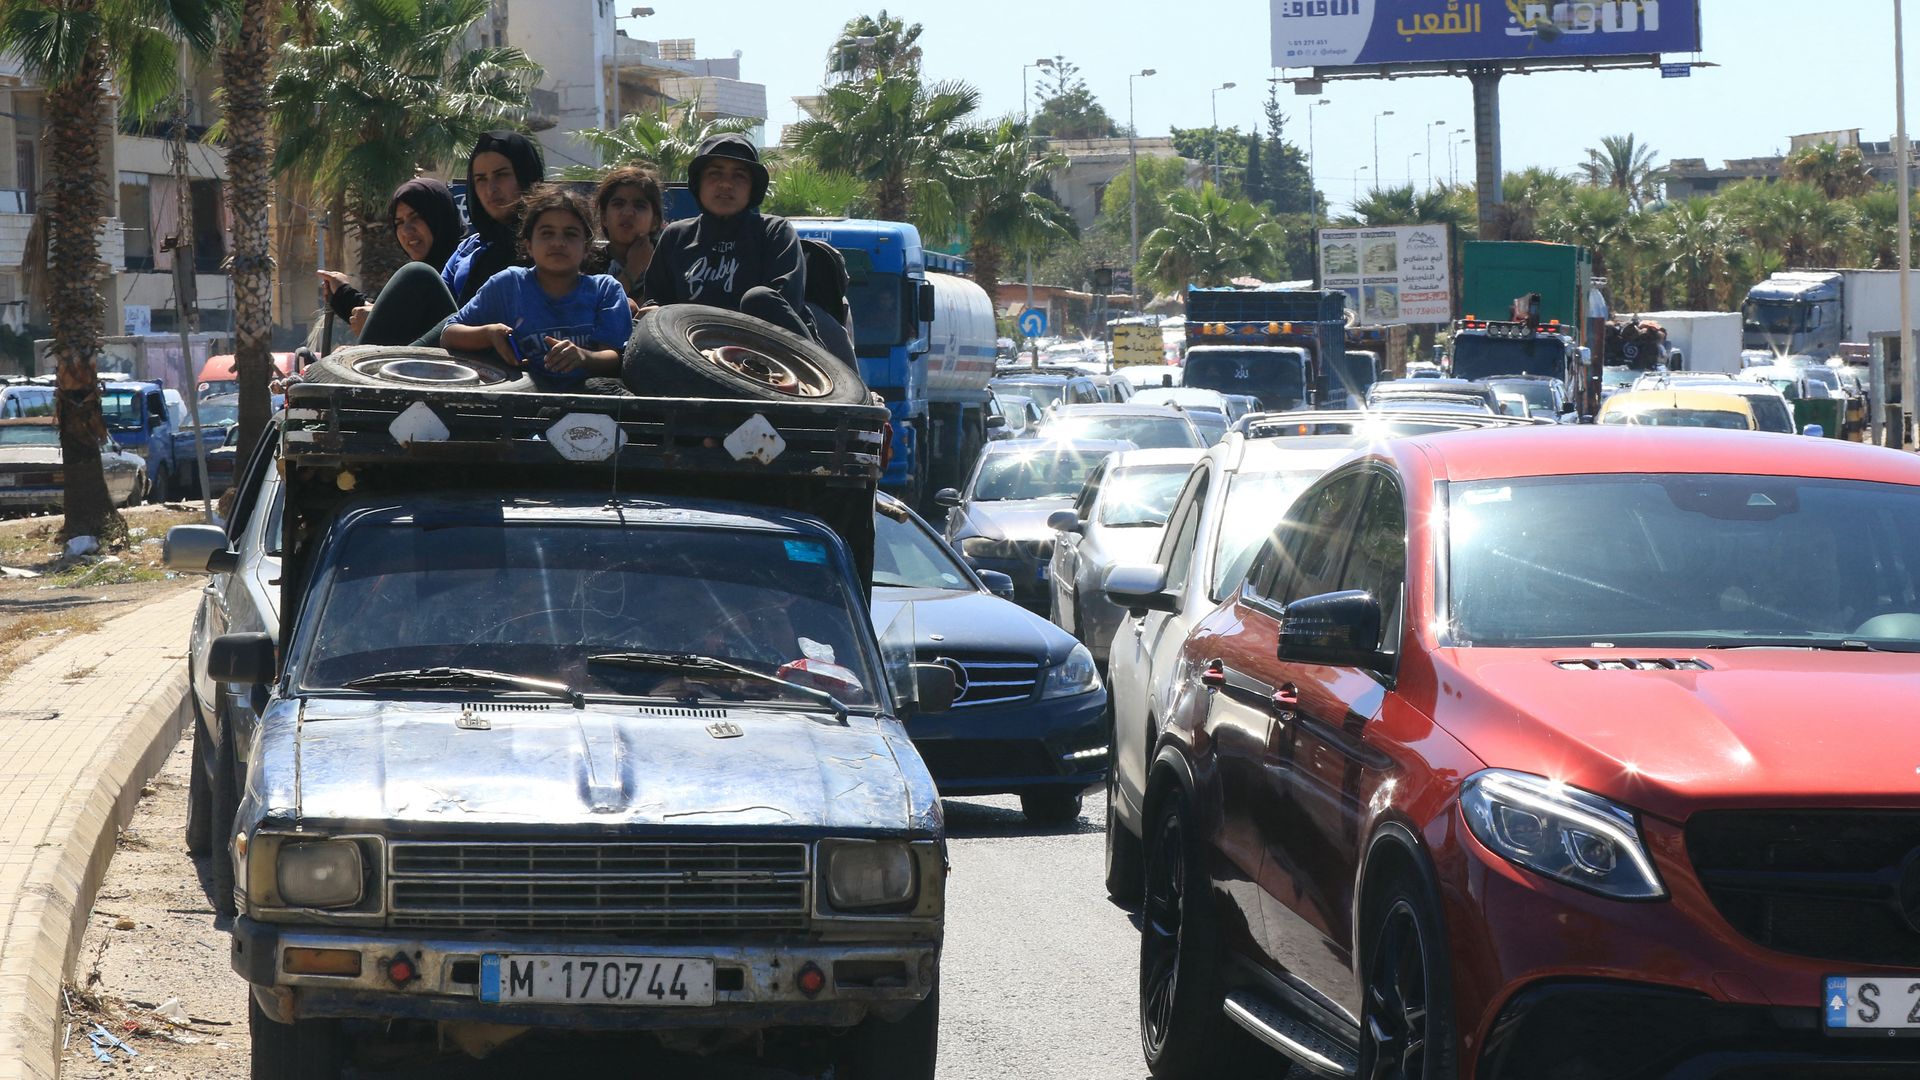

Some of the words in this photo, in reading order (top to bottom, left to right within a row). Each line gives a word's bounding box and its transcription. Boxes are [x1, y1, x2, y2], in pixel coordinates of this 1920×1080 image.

[510, 960, 533, 997] M
[562, 962, 688, 1000] 170744
[1858, 983, 1880, 1023] S
